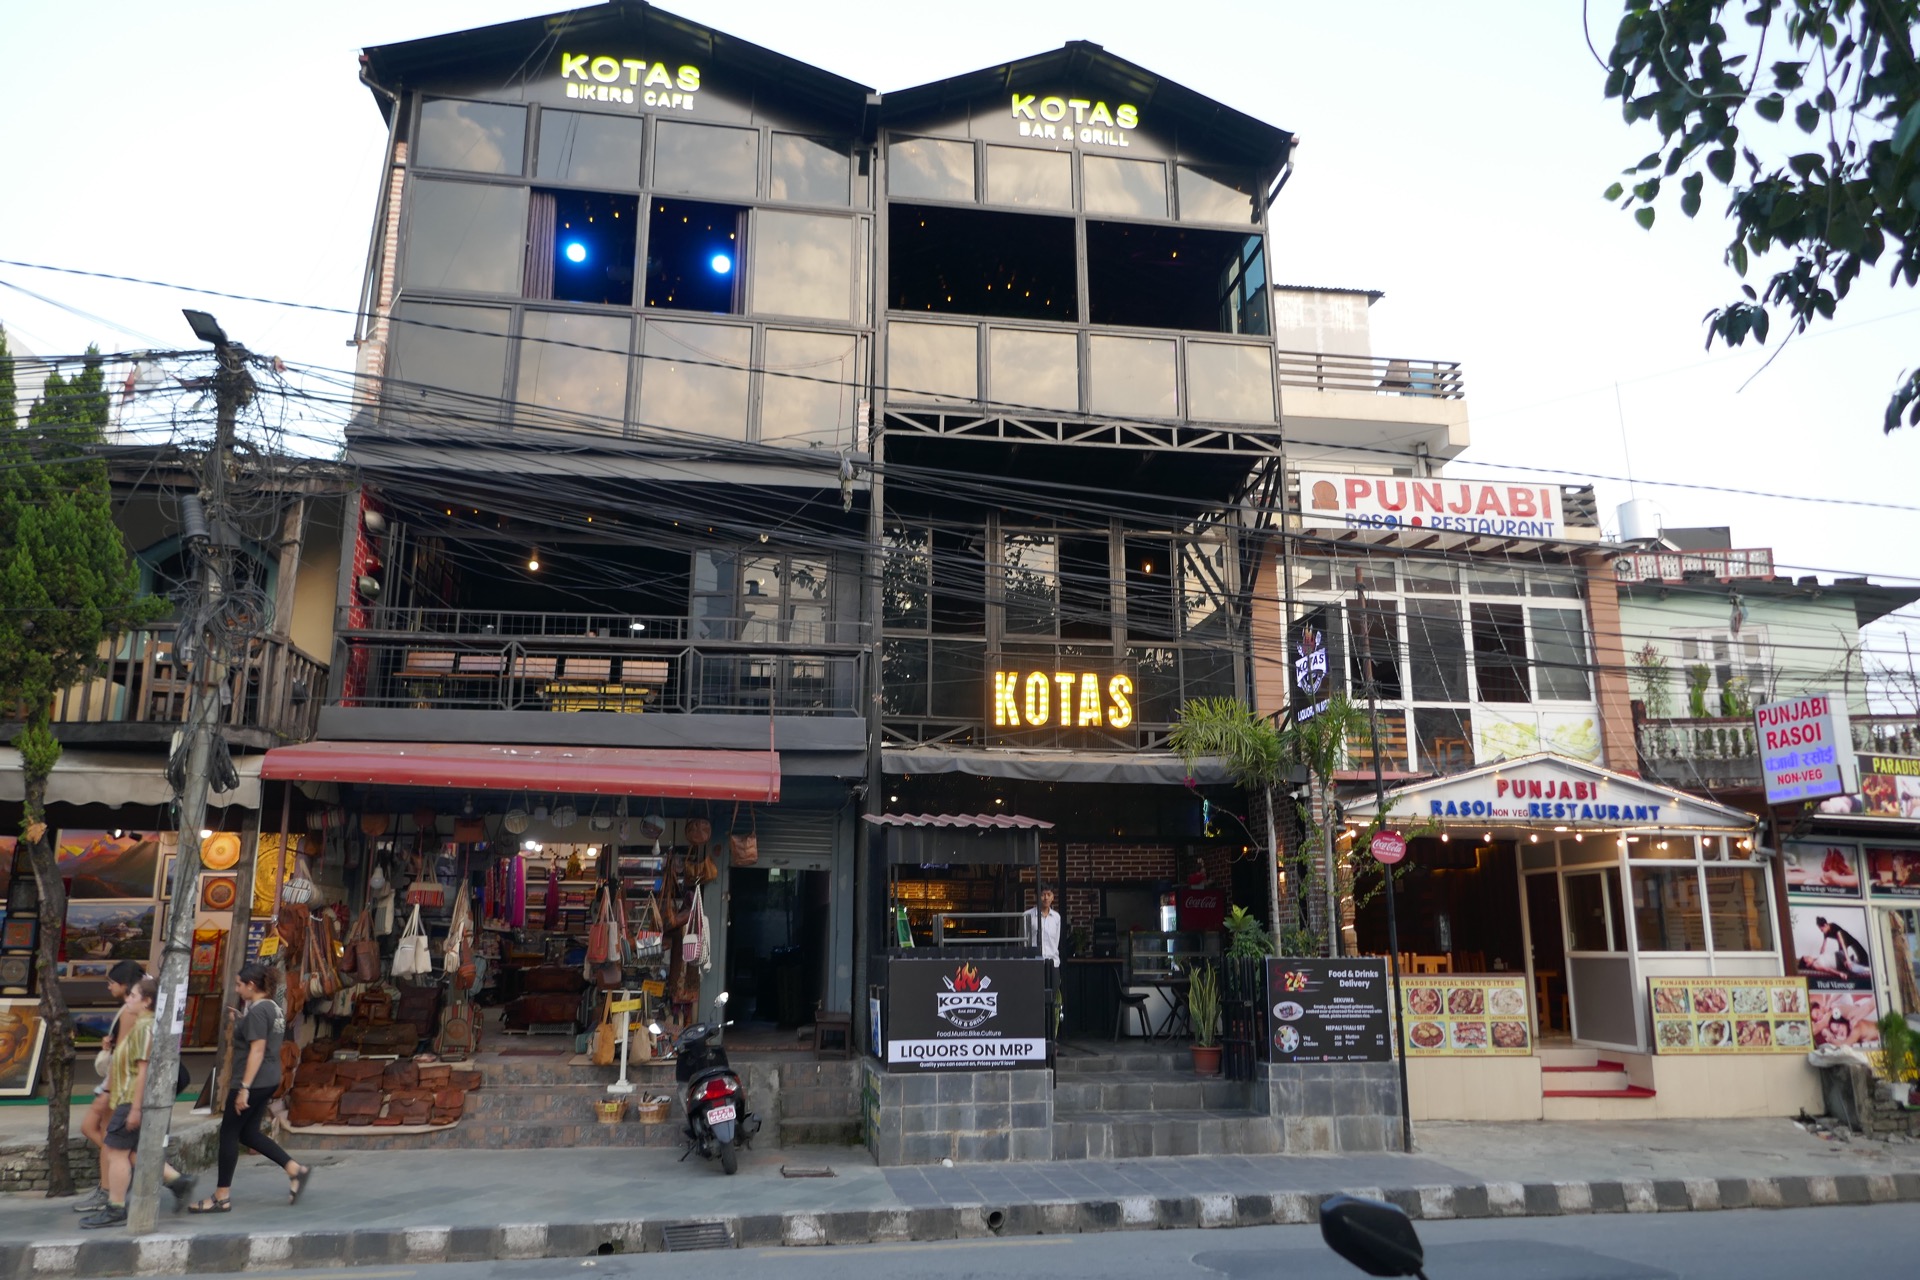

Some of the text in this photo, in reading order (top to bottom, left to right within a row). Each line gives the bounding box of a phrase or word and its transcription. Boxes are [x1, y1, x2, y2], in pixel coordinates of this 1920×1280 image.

[561, 52, 701, 91] KOTAS
[566, 82, 694, 110] BIKERS CAFE
[1011, 93, 1138, 129] KOTAS
[1019, 121, 1129, 147] BAR & GRILL
[1344, 478, 1552, 519] PUNJABI
[1345, 513, 1555, 537] RASOI RESTAURANT
[995, 671, 1133, 728] KOTAS
[1758, 696, 1828, 728] PUNJABI
[1766, 722, 1822, 750] RASOI
[1777, 768, 1823, 785] NON-VEG
[1872, 757, 1920, 776] PARADIS
[1497, 779, 1597, 800] PUNJABI
[1430, 800, 1660, 820] RASOI NON VEG RESTAURANT
[1328, 970, 1379, 978] Food & Drinks
[1339, 979, 1370, 989] Delivery
[939, 996, 996, 1007] KOTAS
[900, 1043, 1033, 1059] LIQUORS ON MRP
